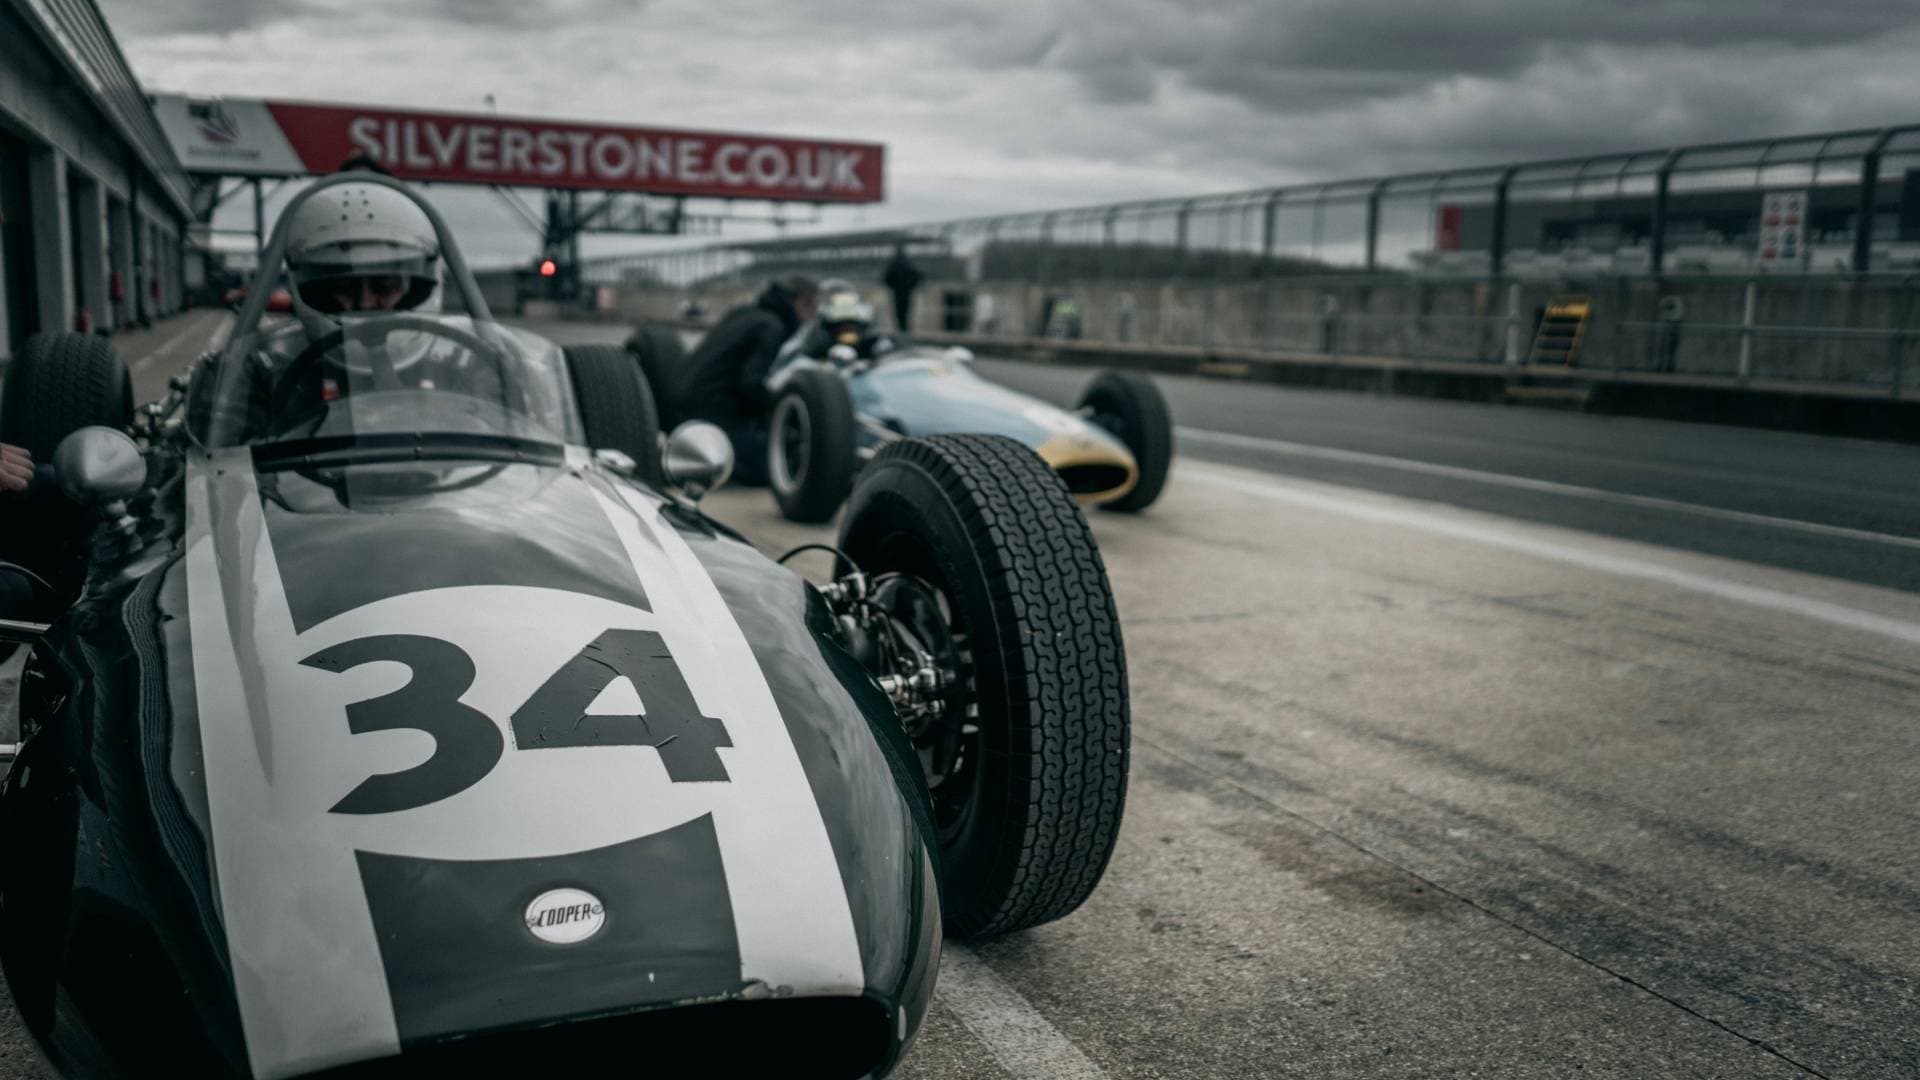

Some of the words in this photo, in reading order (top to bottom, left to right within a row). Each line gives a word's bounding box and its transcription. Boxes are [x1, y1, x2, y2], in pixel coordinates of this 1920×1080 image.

[350, 117, 865, 191] SILVERSTONE.CO.UK
[298, 628, 734, 815] 34
[537, 903, 592, 927] COOPER
